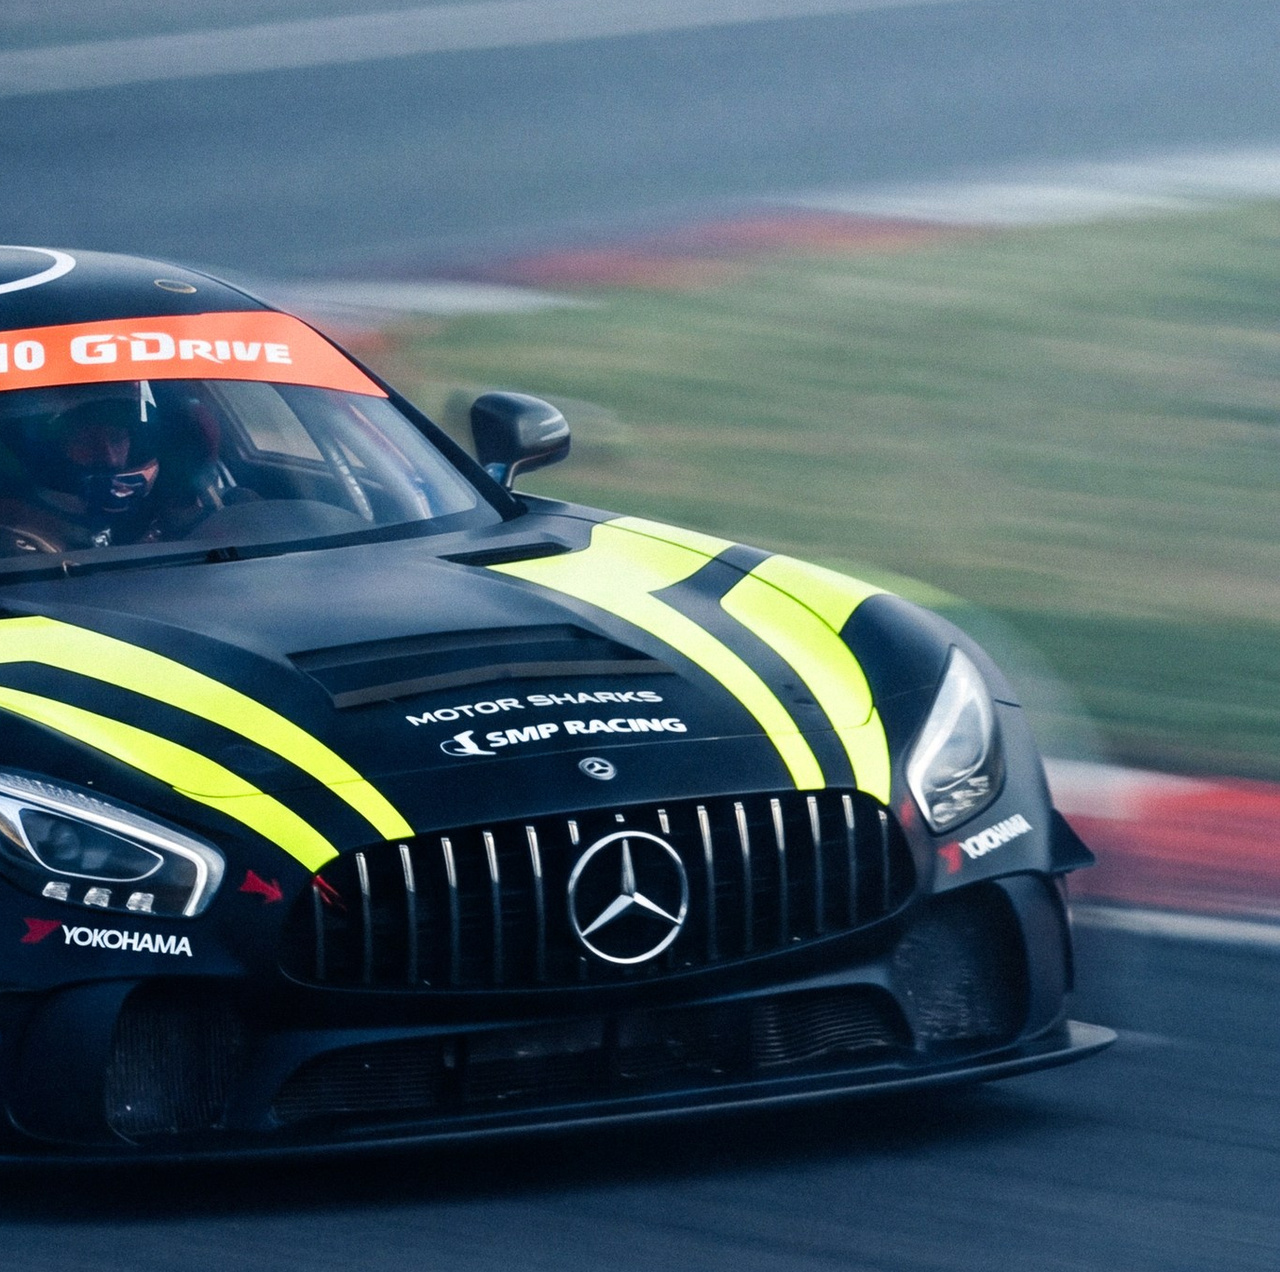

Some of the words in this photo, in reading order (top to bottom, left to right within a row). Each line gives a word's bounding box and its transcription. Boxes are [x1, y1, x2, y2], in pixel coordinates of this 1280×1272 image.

[405, 697, 525, 727] MOTOR
[527, 690, 664, 707] SHARKS
[485, 722, 559, 748] SMP
[563, 717, 688, 735] RACING
[62, 924, 193, 957] YOKOHAMA
